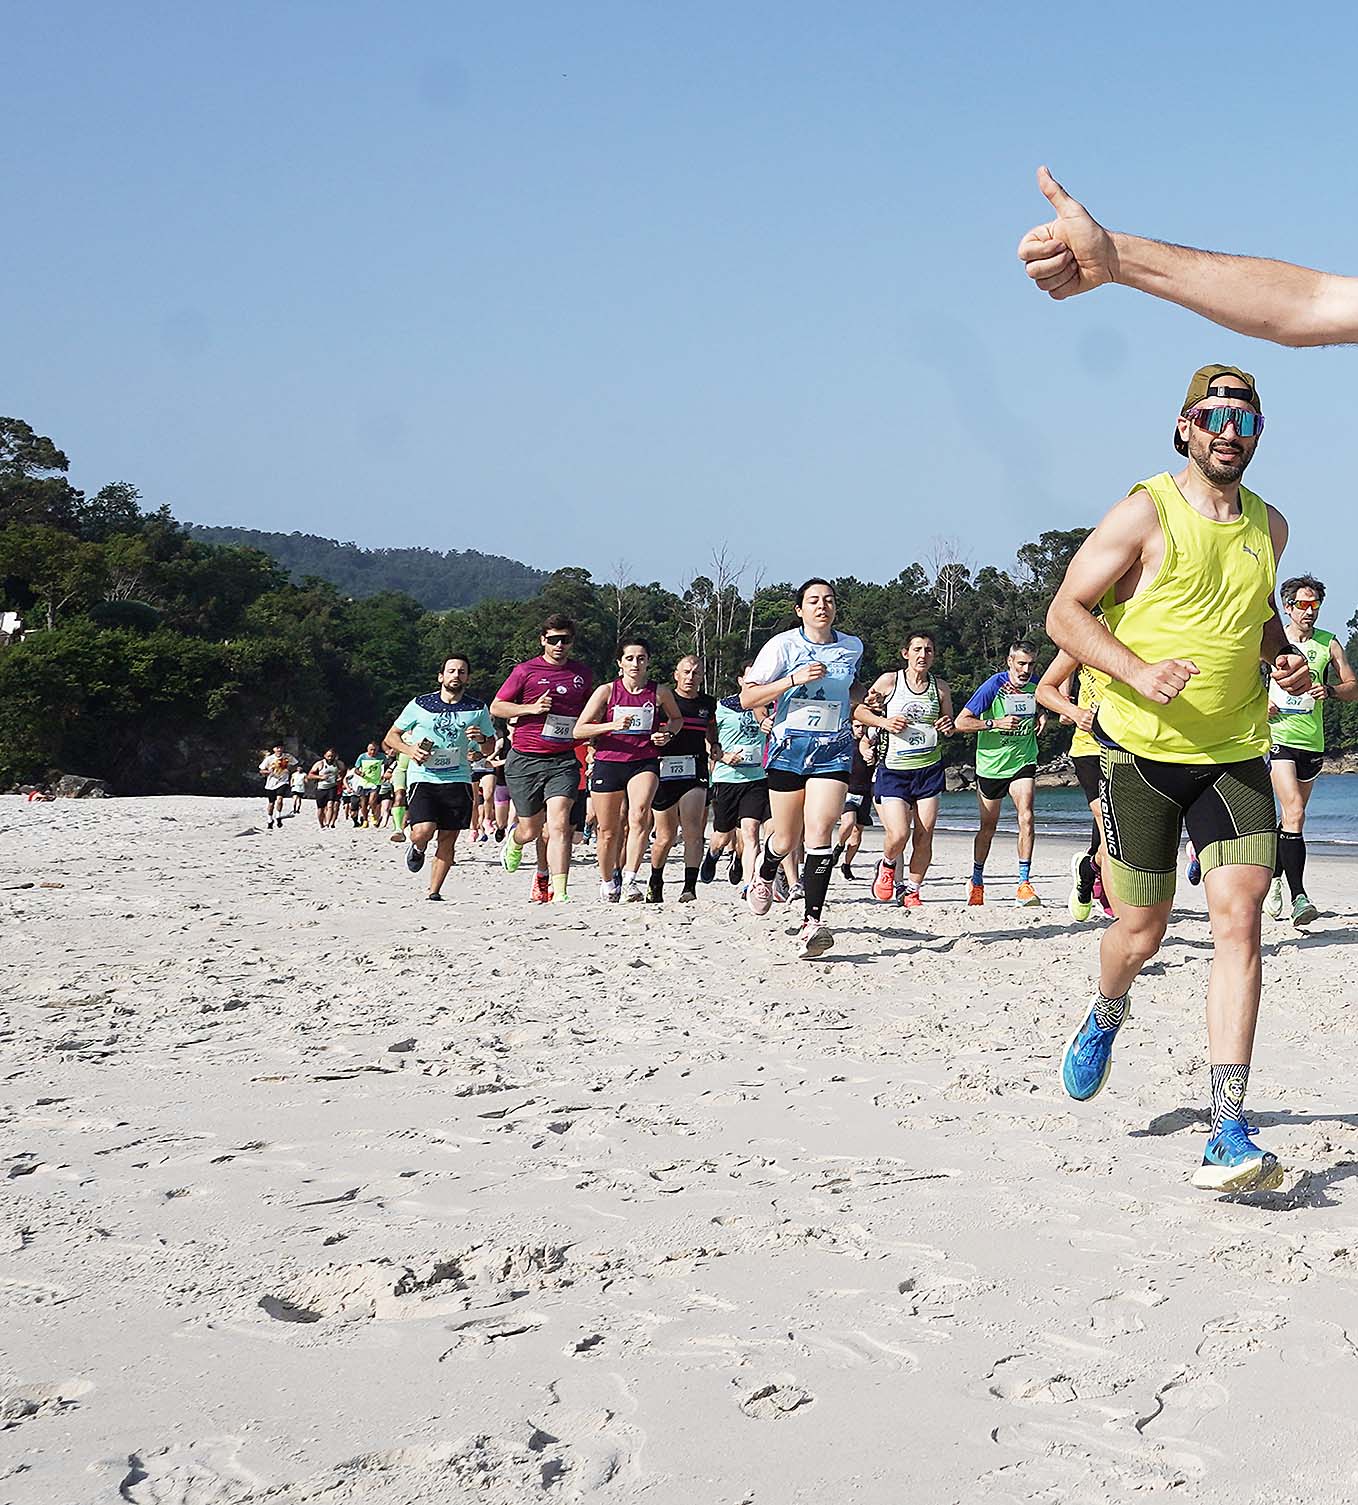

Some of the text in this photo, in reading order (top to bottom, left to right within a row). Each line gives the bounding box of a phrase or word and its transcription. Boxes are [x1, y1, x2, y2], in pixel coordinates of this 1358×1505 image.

[1286, 695, 1303, 706] 257
[807, 715, 822, 727] 77
[1101, 802, 1117, 856] BIONIC
